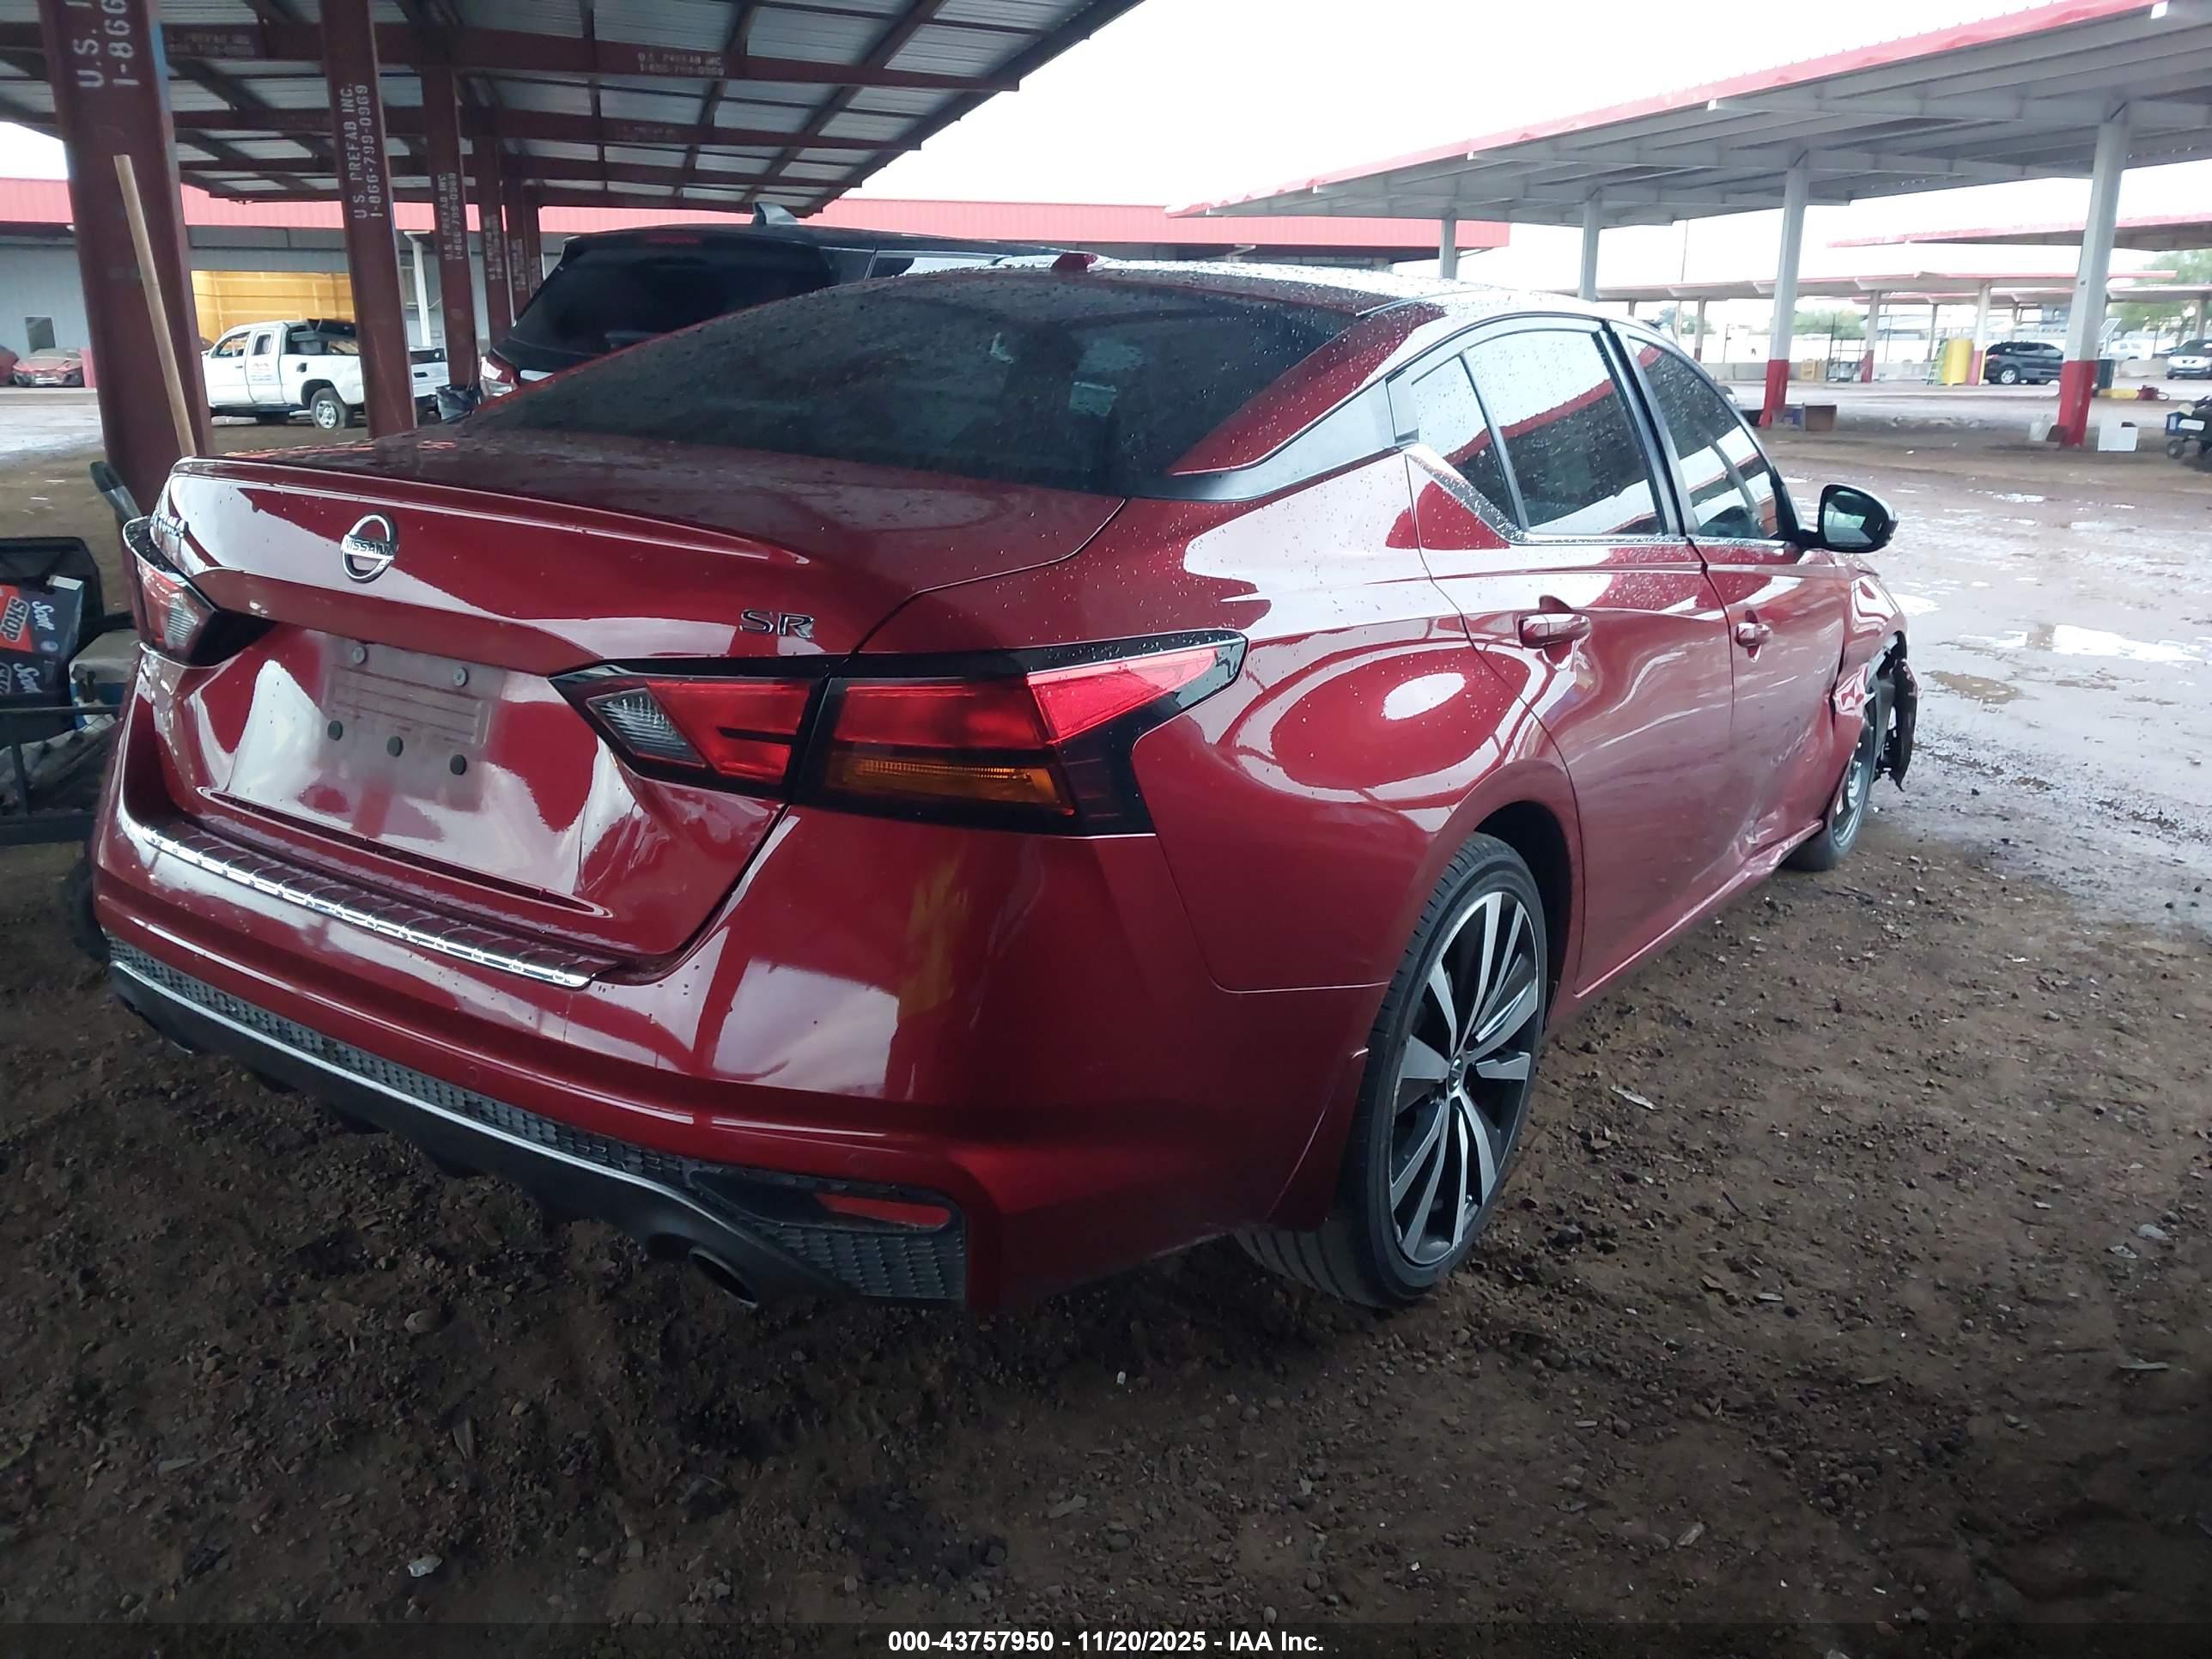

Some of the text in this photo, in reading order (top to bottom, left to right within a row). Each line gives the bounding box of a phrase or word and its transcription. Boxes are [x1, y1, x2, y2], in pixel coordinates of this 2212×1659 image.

[73, 28, 105, 88] U.S.
[340, 83, 368, 219] U.S. PREFAB INC.
[355, 84, 384, 218] 1-866-799-0969
[3, 598, 26, 641] SHOP
[32, 600, 55, 631] Scott
[739, 608, 815, 639] SR
